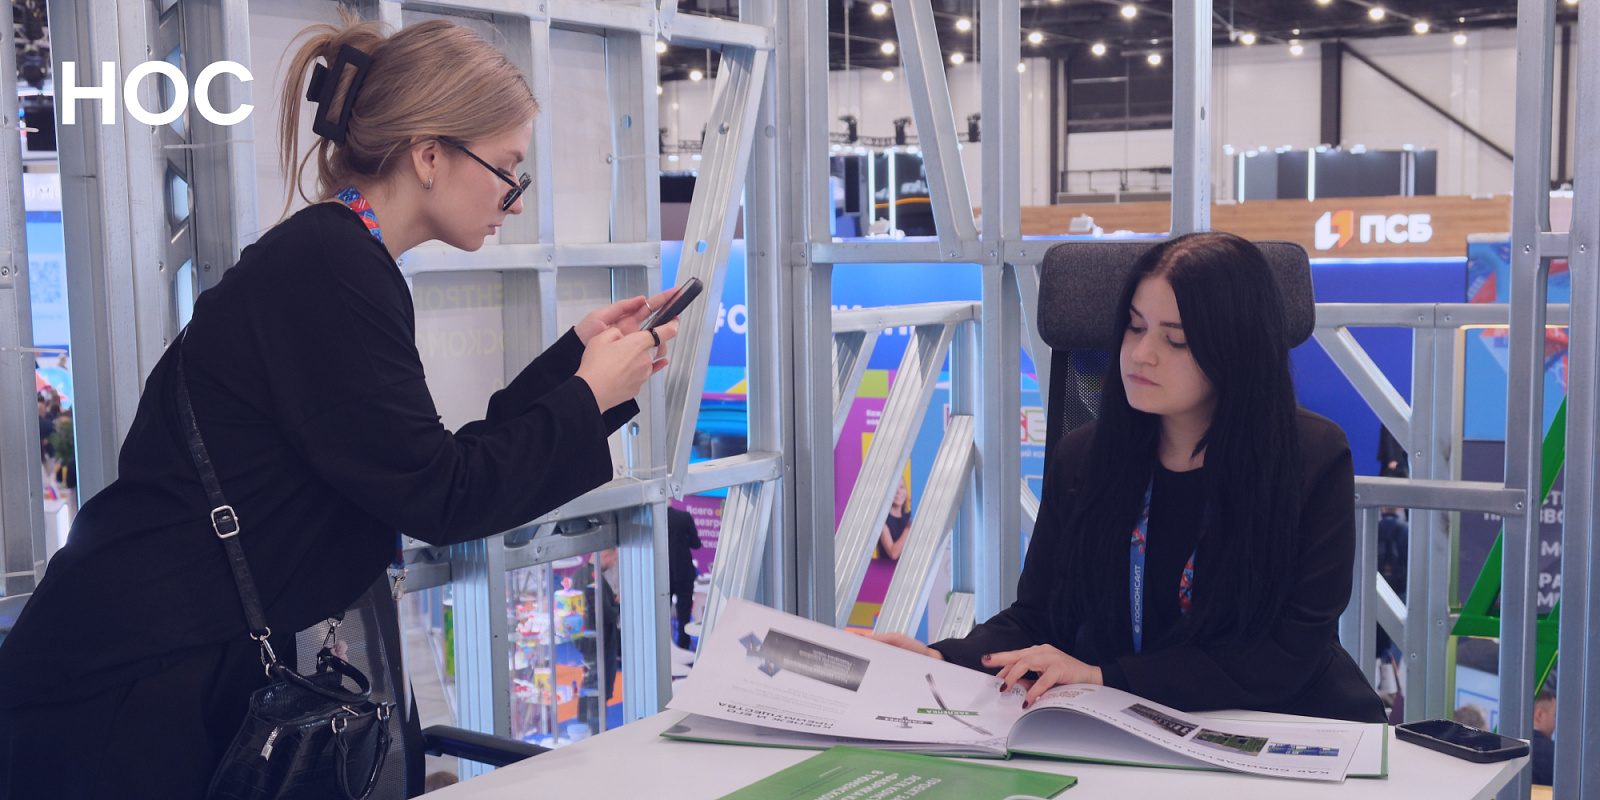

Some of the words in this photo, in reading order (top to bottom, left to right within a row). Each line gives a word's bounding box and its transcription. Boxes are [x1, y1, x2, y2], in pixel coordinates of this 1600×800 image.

[1360, 213, 1434, 244] ПСБ
[718, 701, 834, 728] ПРЕИМУЩЕСТВА
[726, 708, 752, 718] ЕГО
[773, 717, 832, 730] КРЕПЕЖ
